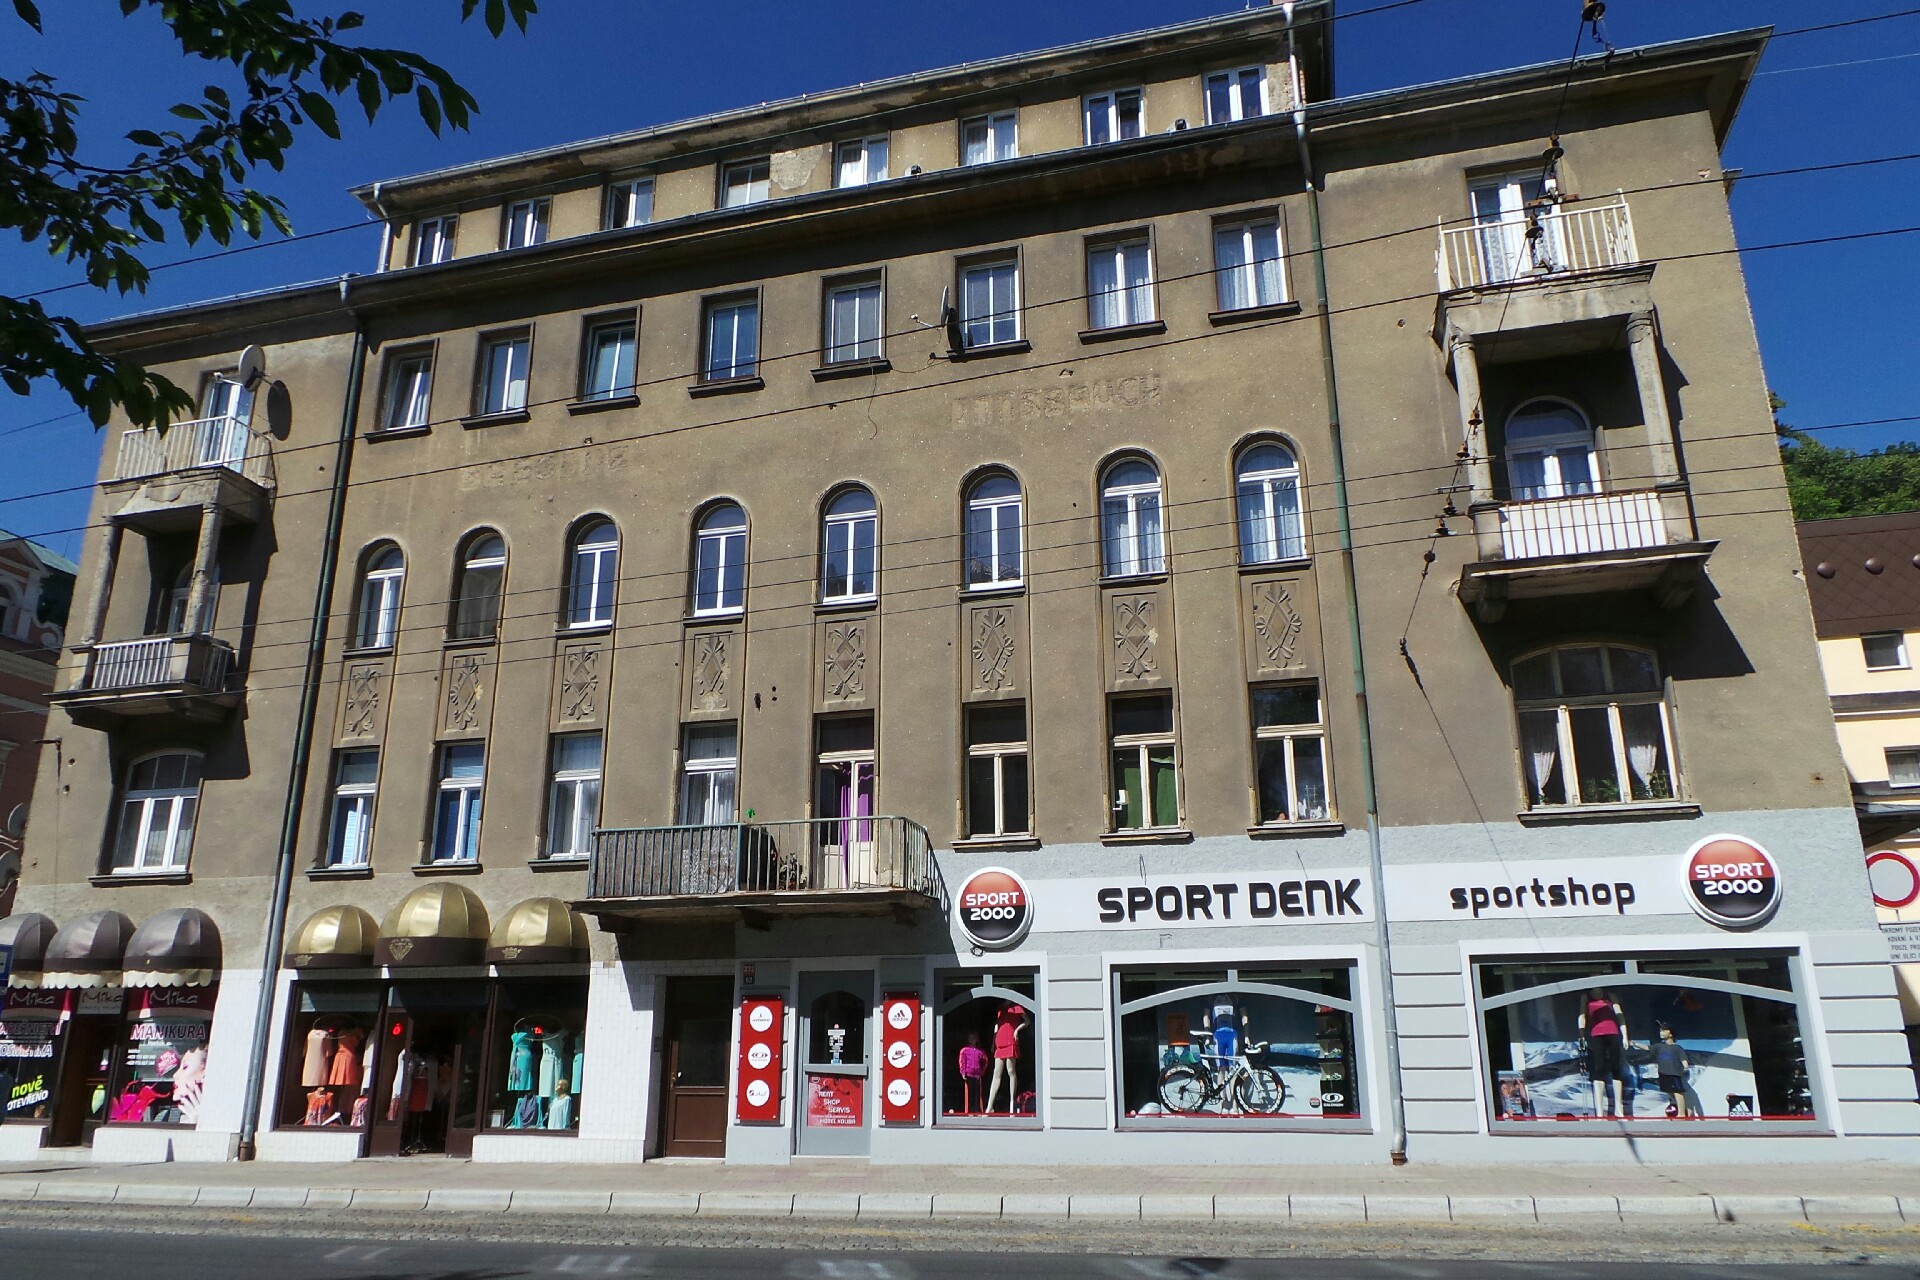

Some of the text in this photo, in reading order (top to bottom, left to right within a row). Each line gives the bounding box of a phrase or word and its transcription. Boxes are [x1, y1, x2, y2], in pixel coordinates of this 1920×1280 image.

[1694, 862, 1765, 879] SPORT
[1703, 878, 1763, 895] 2000
[965, 891, 1019, 906] SPORT
[1097, 878, 1364, 923] SPORT DENK
[1449, 876, 1636, 918] sportshop
[970, 906, 1016, 921] 2000
[9, 991, 55, 1005] Mika
[82, 991, 122, 1003] Mika
[149, 991, 198, 1005] Mika
